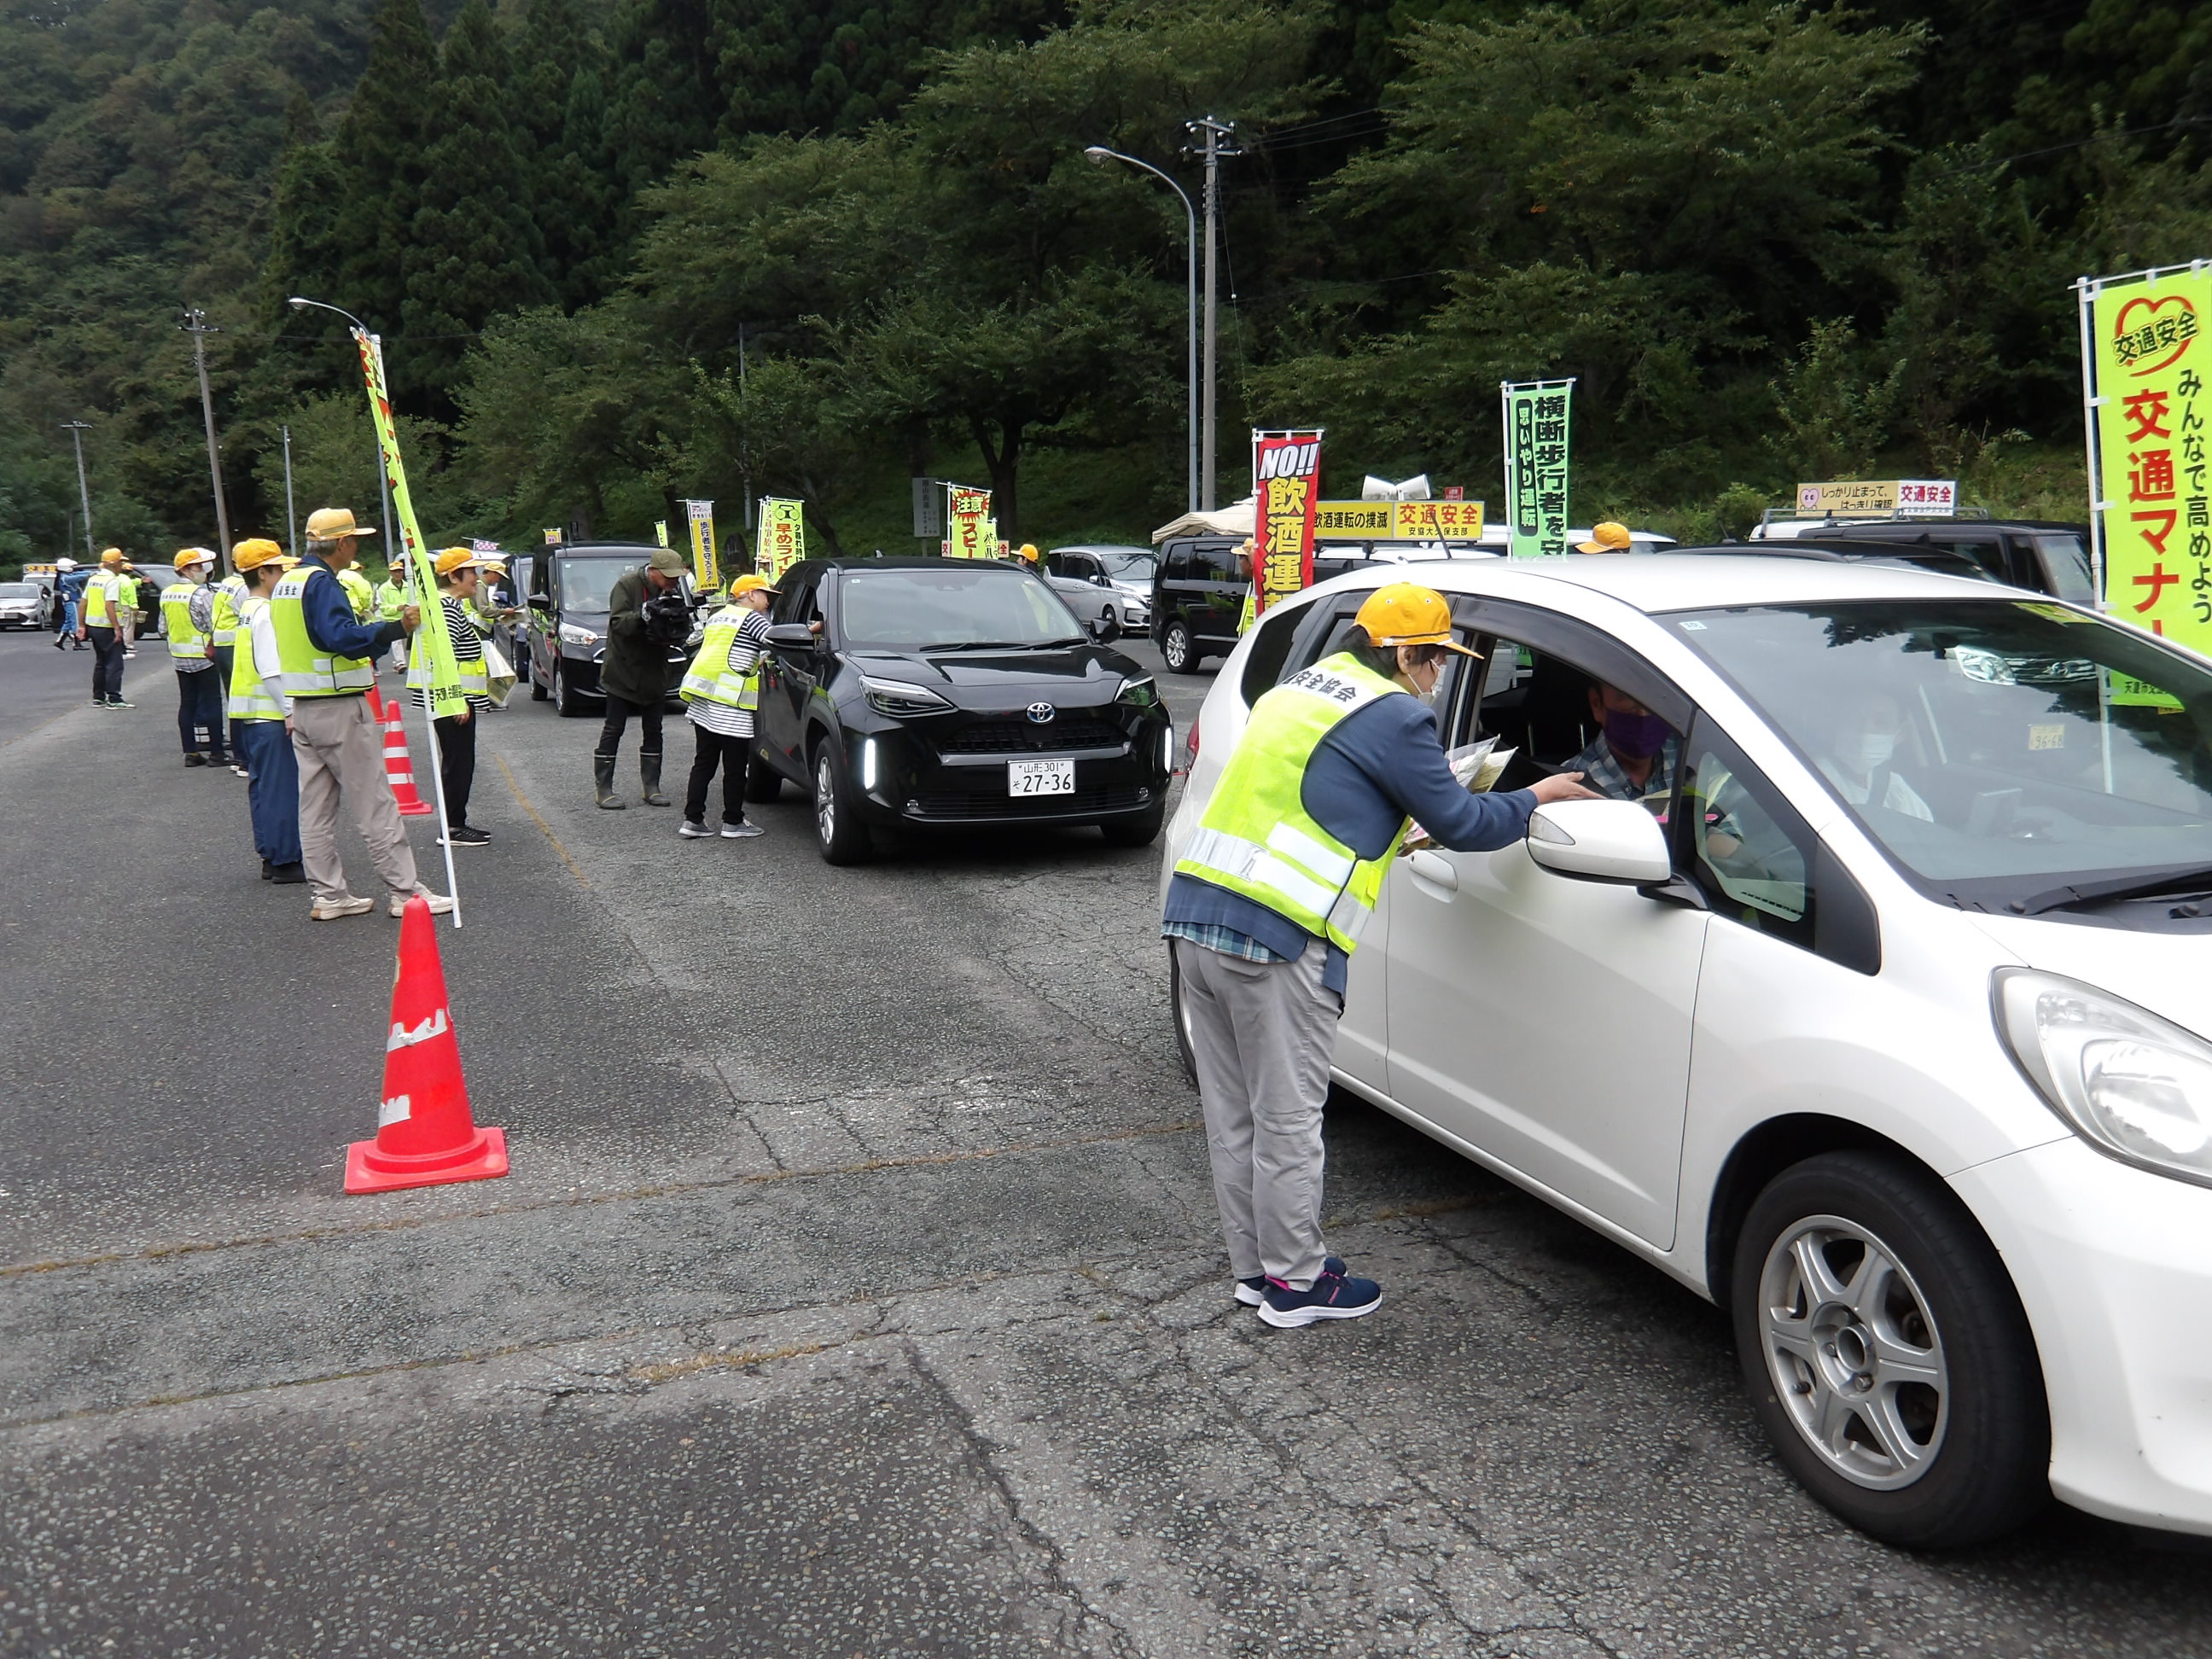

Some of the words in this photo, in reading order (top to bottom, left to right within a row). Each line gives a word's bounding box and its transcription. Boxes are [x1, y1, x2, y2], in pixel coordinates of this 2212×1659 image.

[2113, 310, 2199, 365] 交通安全
[1258, 442, 1319, 480] NO!!
[1518, 407, 1537, 527] 思いやり運転
[1900, 485, 1952, 503] 交通安全
[2176, 368, 2212, 624] みんなで高めよう
[956, 496, 984, 514] 注意
[1399, 504, 1478, 525] 交通安全
[1314, 511, 1388, 529] 飲酒運転の撲滅
[1284, 670, 1358, 702] 安全協会
[1023, 763, 1043, 773] 山形
[1044, 762, 1059, 772] 301
[1022, 772, 1072, 792] 27-36
